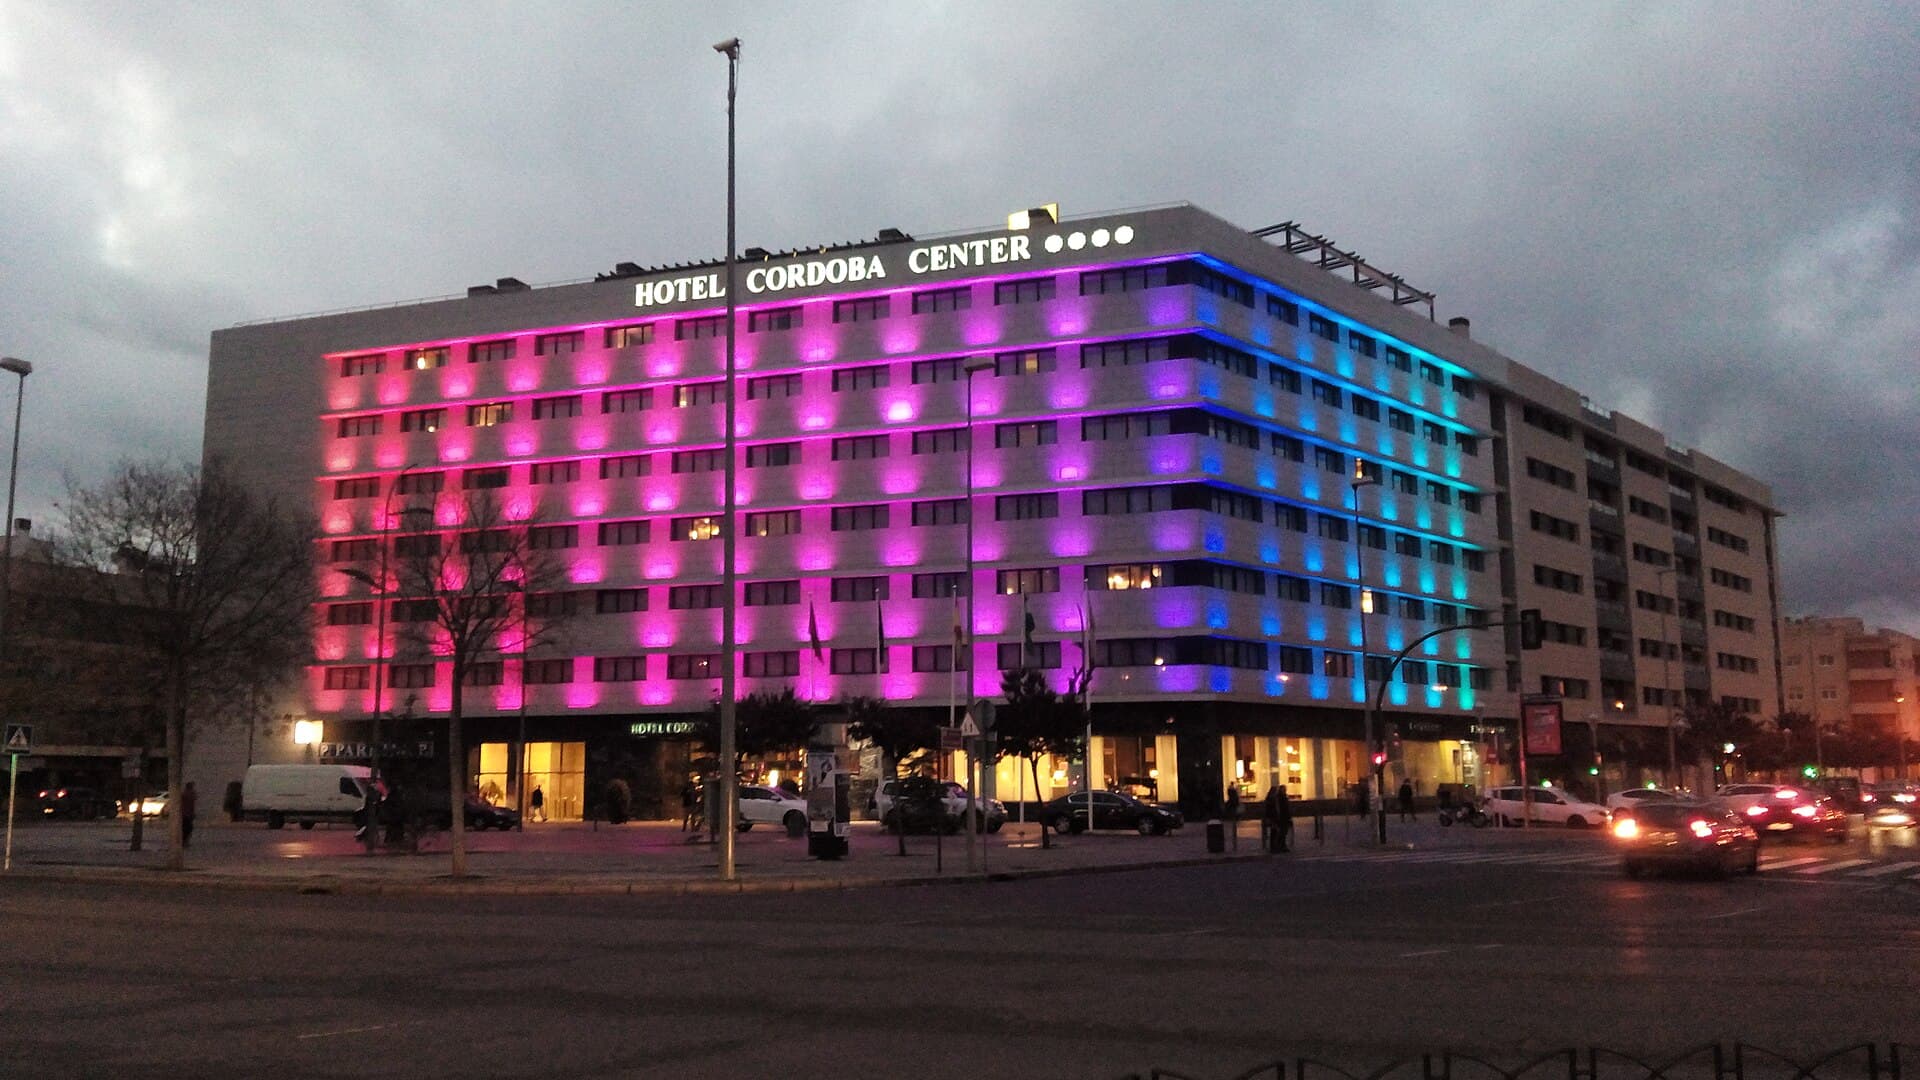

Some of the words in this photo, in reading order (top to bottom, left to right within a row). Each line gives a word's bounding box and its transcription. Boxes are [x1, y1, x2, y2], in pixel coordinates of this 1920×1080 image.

[634, 273, 726, 307] HOTEL
[745, 255, 886, 294] CORDOBA
[908, 235, 1031, 274] CENTER
[631, 722, 664, 735] HOTEL
